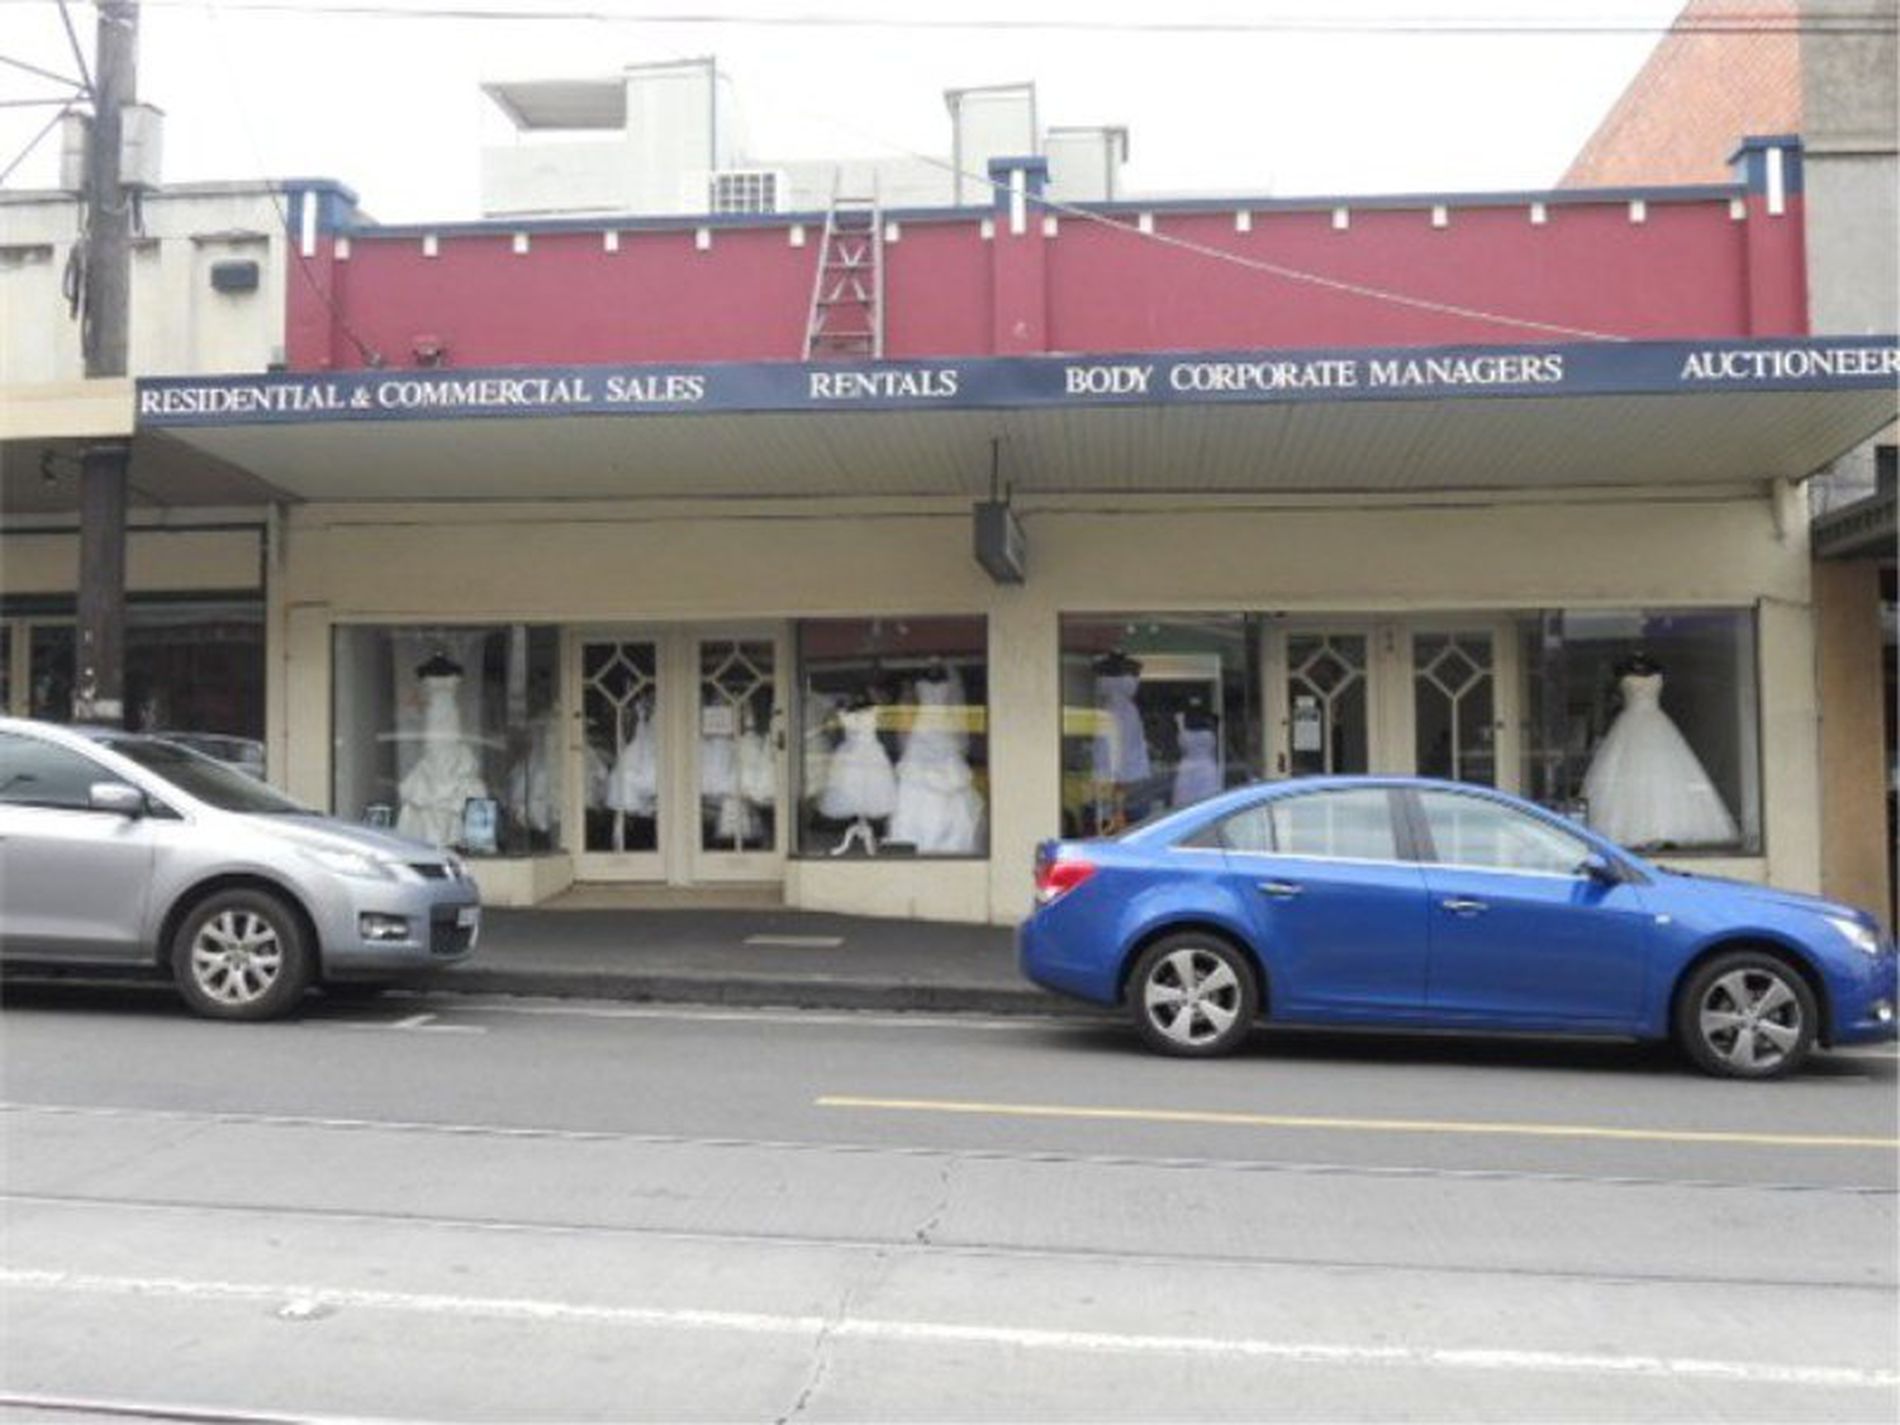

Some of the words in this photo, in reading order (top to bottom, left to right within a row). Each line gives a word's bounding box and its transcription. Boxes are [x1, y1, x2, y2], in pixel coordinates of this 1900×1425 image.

[141, 382, 346, 414] RESIDENTIAL
[350, 387, 371, 409] &
[377, 377, 592, 408] COMMERCIAL
[605, 374, 706, 403] SALES
[809, 368, 958, 399] RENTALS
[1065, 364, 1154, 394] BODY
[1169, 359, 1358, 391] CORPORATE
[1369, 354, 1563, 387] MANAGERS
